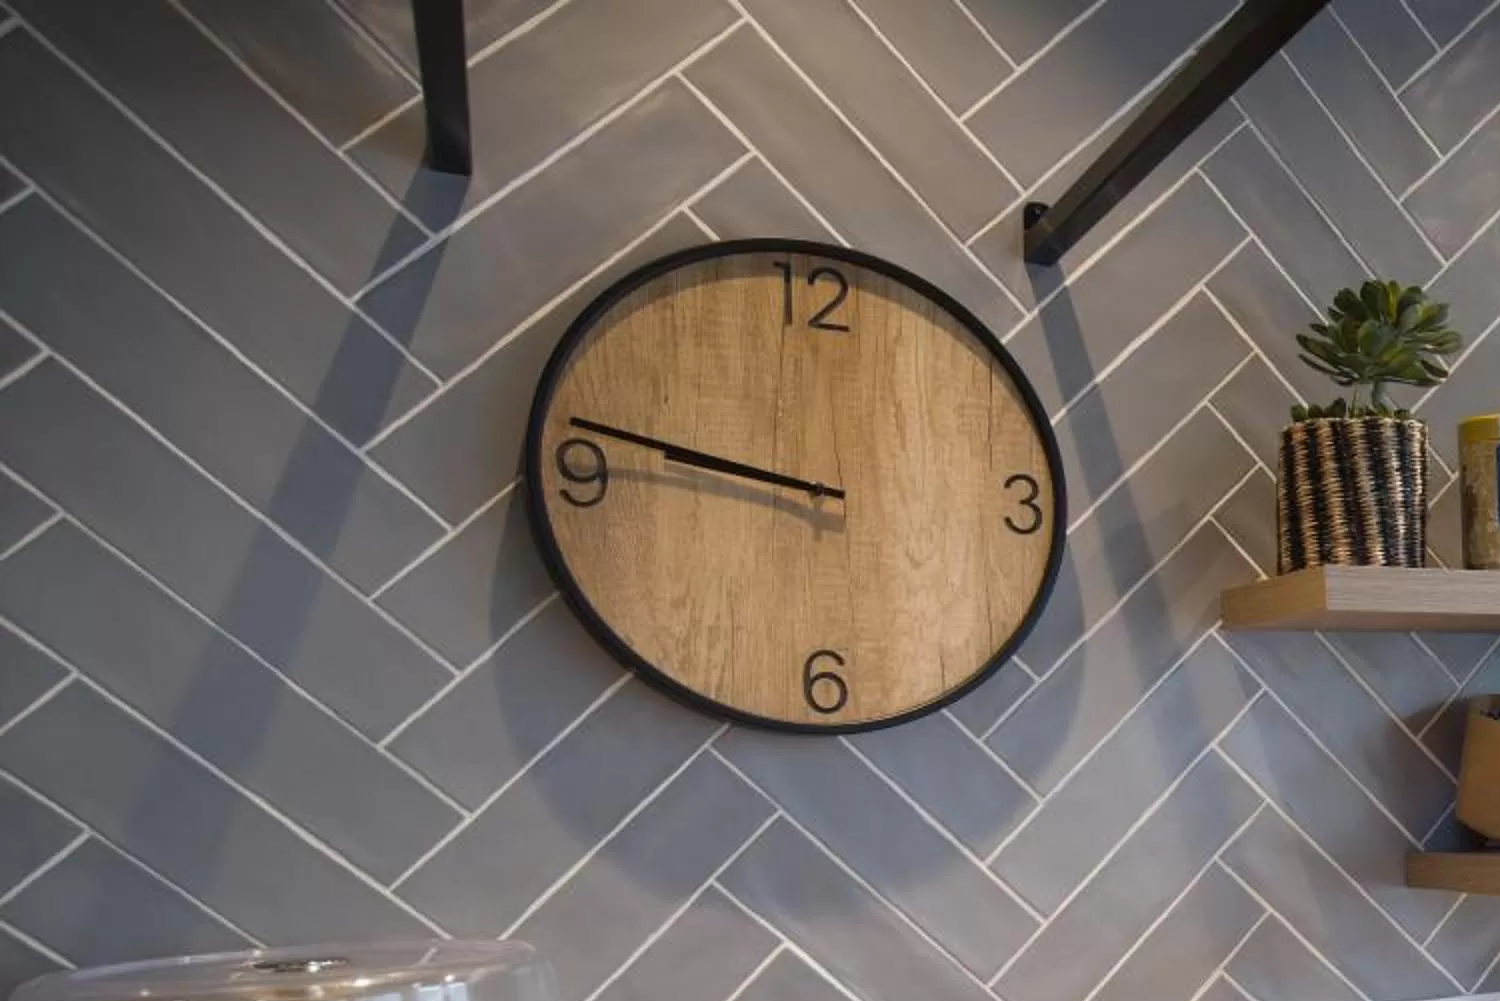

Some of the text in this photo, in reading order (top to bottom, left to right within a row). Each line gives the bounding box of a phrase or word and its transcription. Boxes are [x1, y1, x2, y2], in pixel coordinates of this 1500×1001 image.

[773, 261, 851, 332] 12
[554, 438, 609, 507] 9
[1003, 473, 1044, 535] 3
[802, 649, 849, 715] 6
